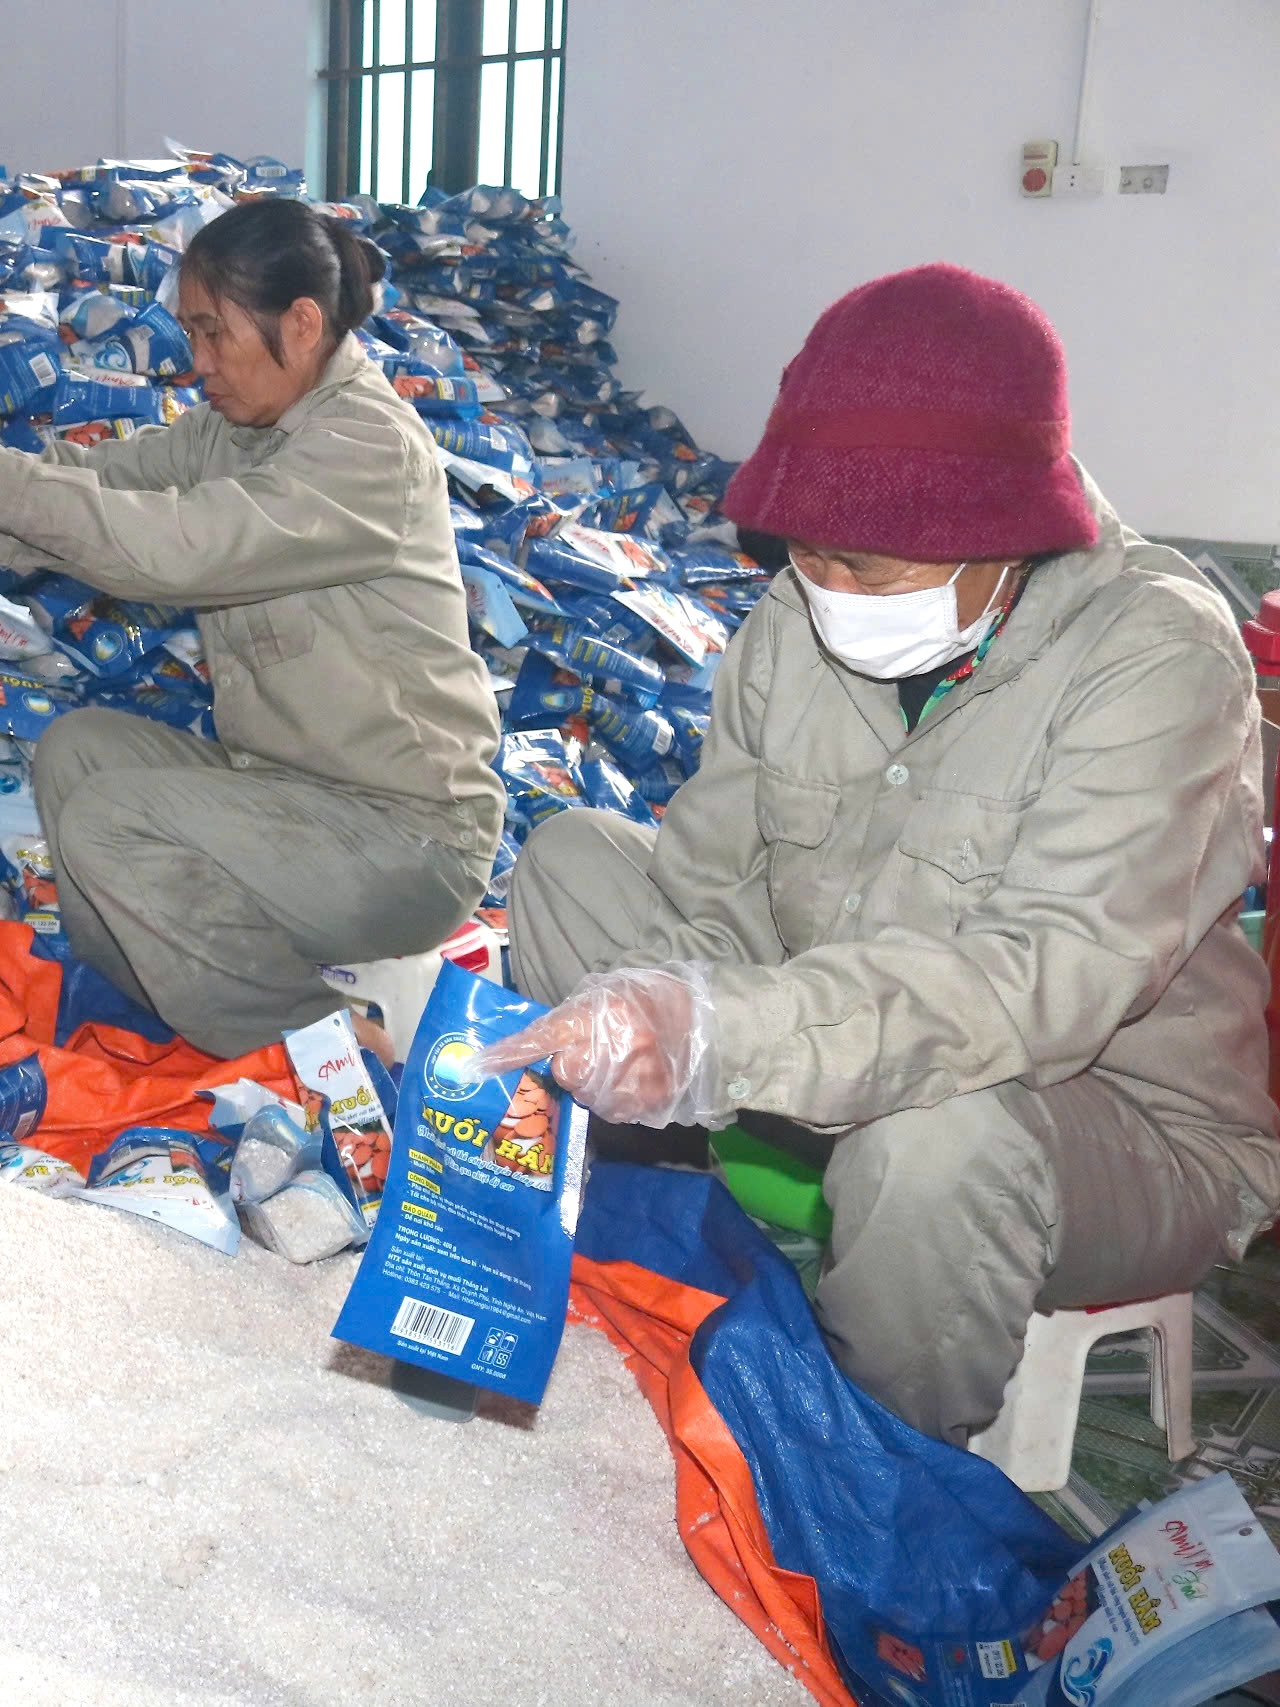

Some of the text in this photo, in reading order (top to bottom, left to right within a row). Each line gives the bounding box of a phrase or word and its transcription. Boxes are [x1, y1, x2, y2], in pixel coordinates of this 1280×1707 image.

[388, 1253, 401, 1262] HTX
[1108, 1542, 1162, 1636] MUỐI HẦM
